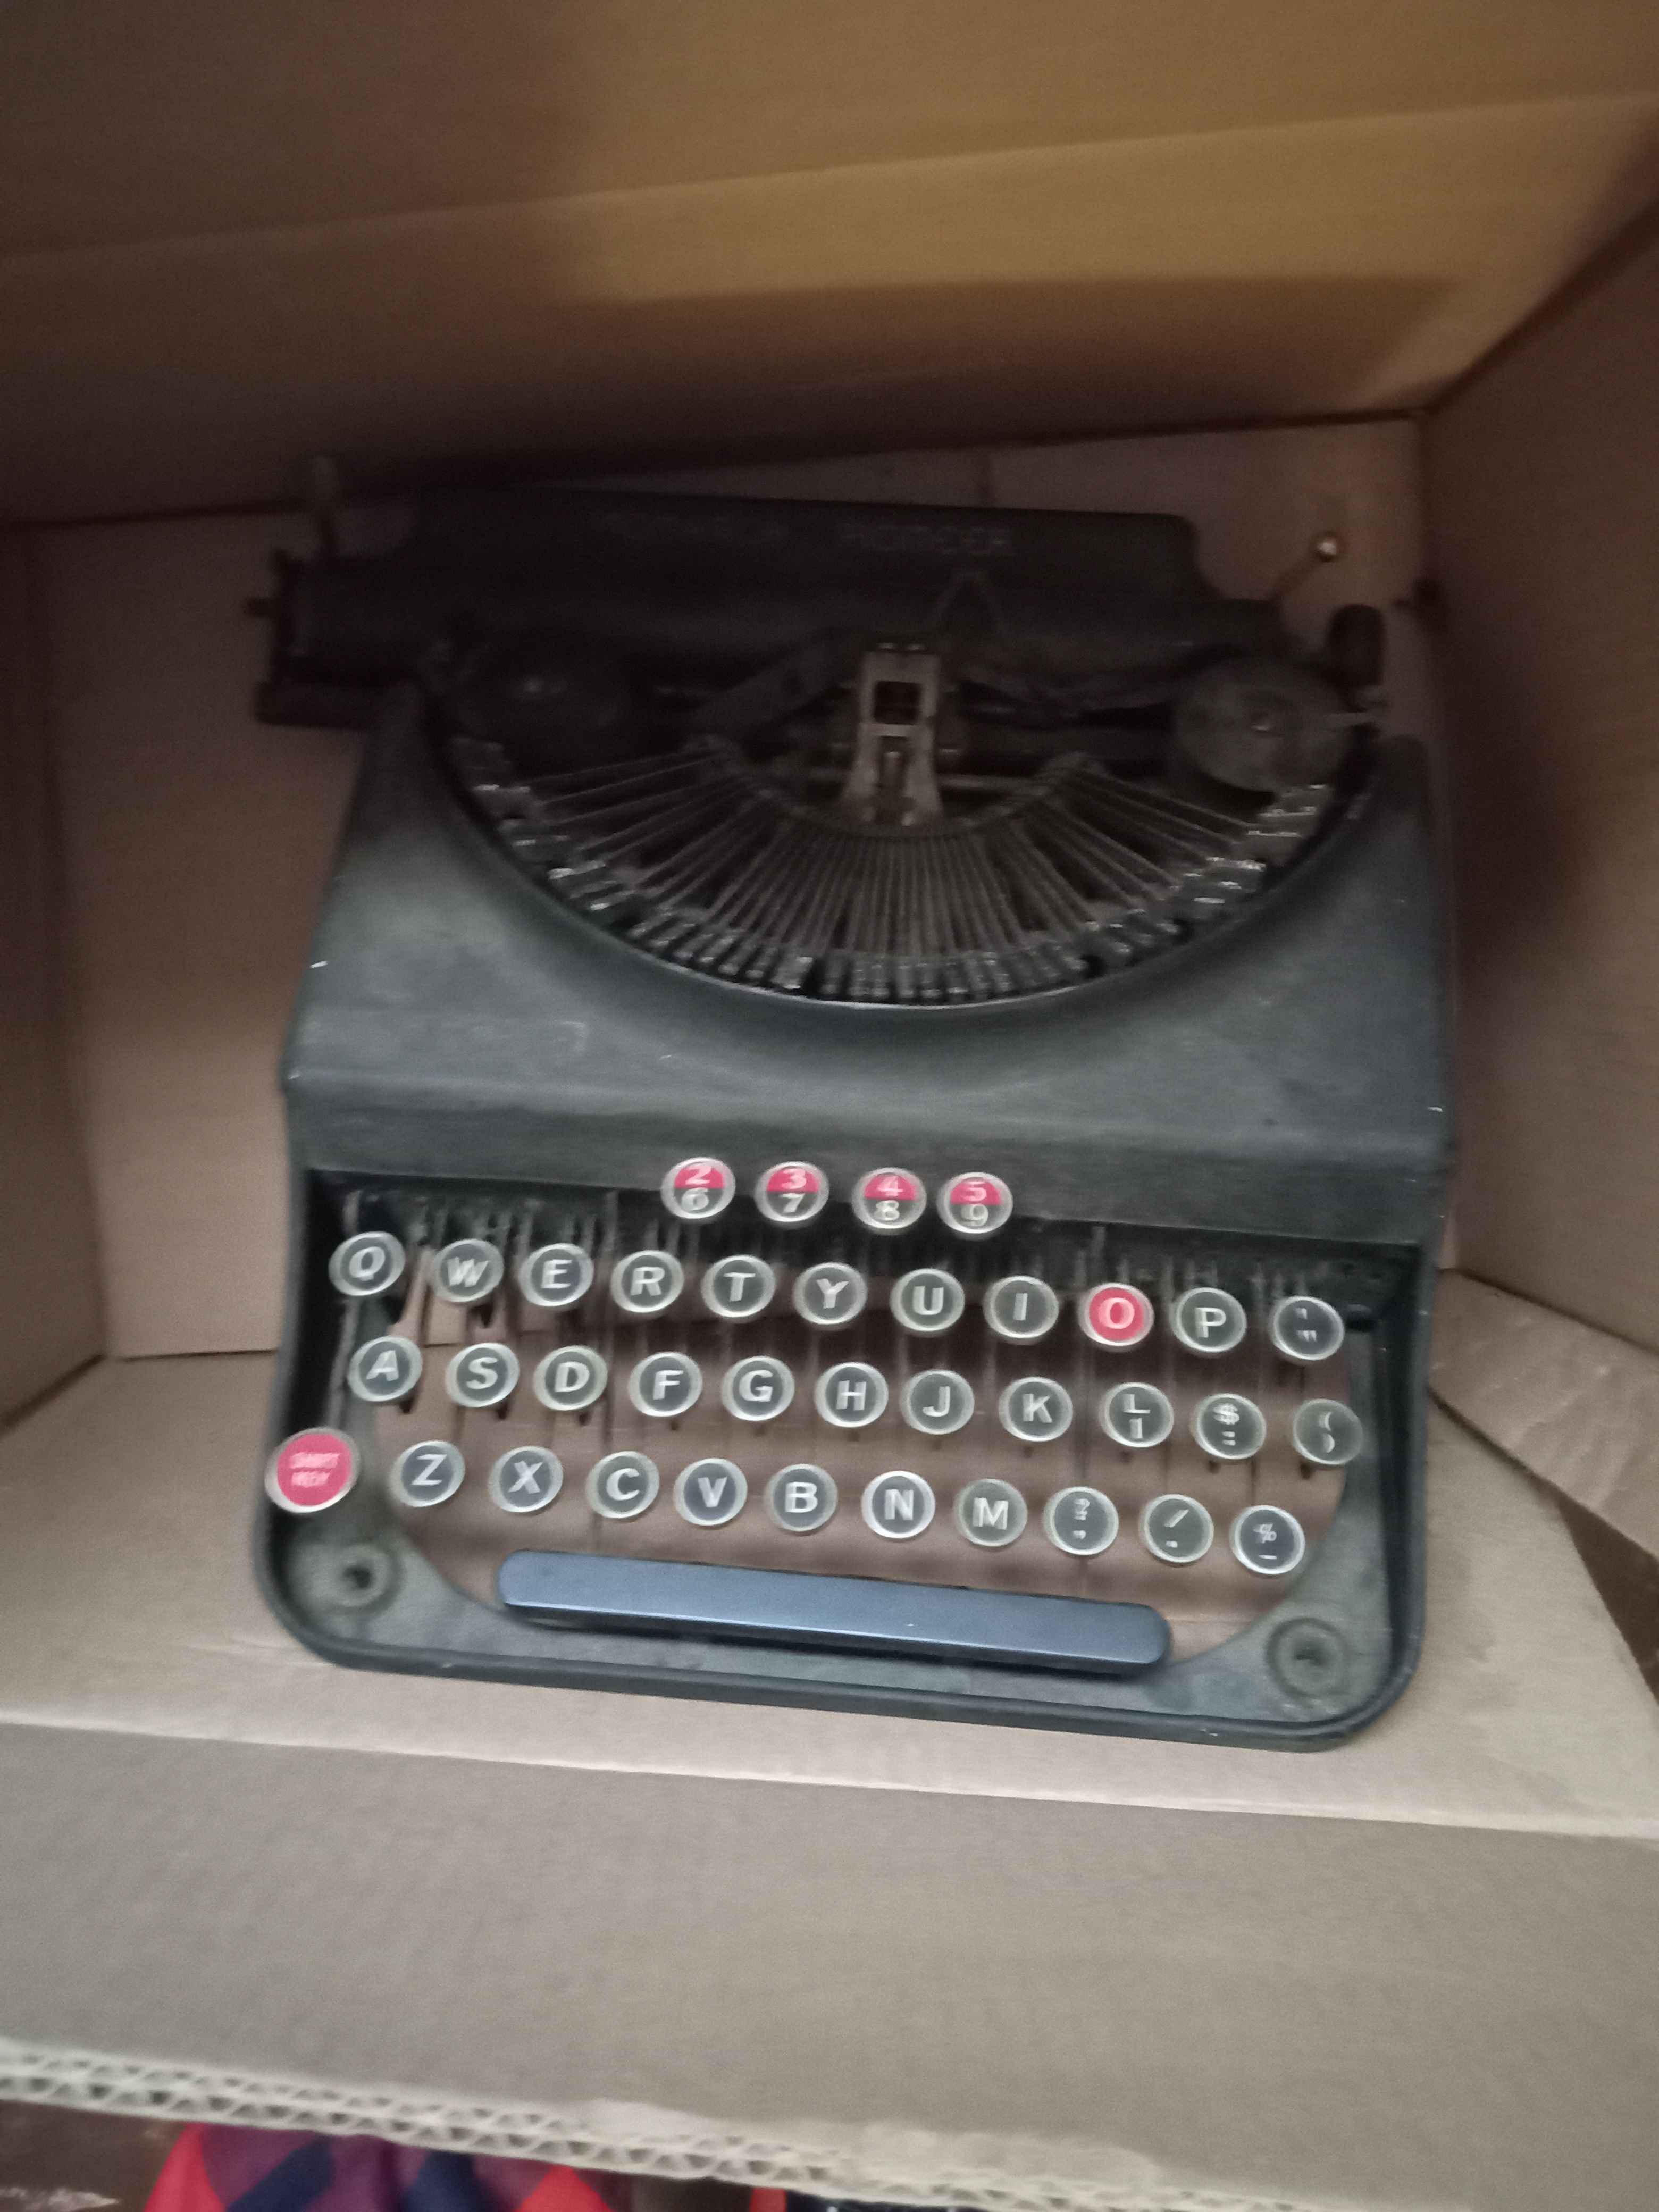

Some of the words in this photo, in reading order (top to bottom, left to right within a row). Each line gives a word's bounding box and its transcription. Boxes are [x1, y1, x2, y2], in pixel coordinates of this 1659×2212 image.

[686, 1166, 711, 1185] 2
[782, 1169, 807, 1189] 3
[877, 1176, 903, 1195] 4
[682, 1188, 709, 1211] 6
[779, 1193, 805, 1213] 7
[963, 1180, 987, 1202] 5
[875, 1200, 900, 1220] 8
[961, 1204, 988, 1226] 9
[447, 1256, 489, 1287] W
[541, 1259, 572, 1289] E
[630, 1267, 665, 1296] R
[724, 1272, 756, 1302] T
[816, 1278, 849, 1309] Y
[912, 1286, 944, 1316] U
[1099, 1297, 1134, 1329] O
[1194, 1308, 1226, 1338] P
[366, 1350, 399, 1381] A
[466, 1357, 498, 1389] S
[555, 1361, 590, 1393] D
[653, 1370, 683, 1400] F
[739, 1370, 773, 1403] G
[836, 1380, 867, 1411] H
[923, 1386, 950, 1417] J
[1022, 1394, 1052, 1423] K
[1121, 1394, 1150, 1413] L
[412, 1454, 447, 1486] Z
[508, 1461, 543, 1494] X
[606, 1468, 640, 1501] C
[698, 1477, 727, 1507] V
[785, 1481, 818, 1513] B
[884, 1489, 914, 1520] N
[972, 1497, 1009, 1530] M
